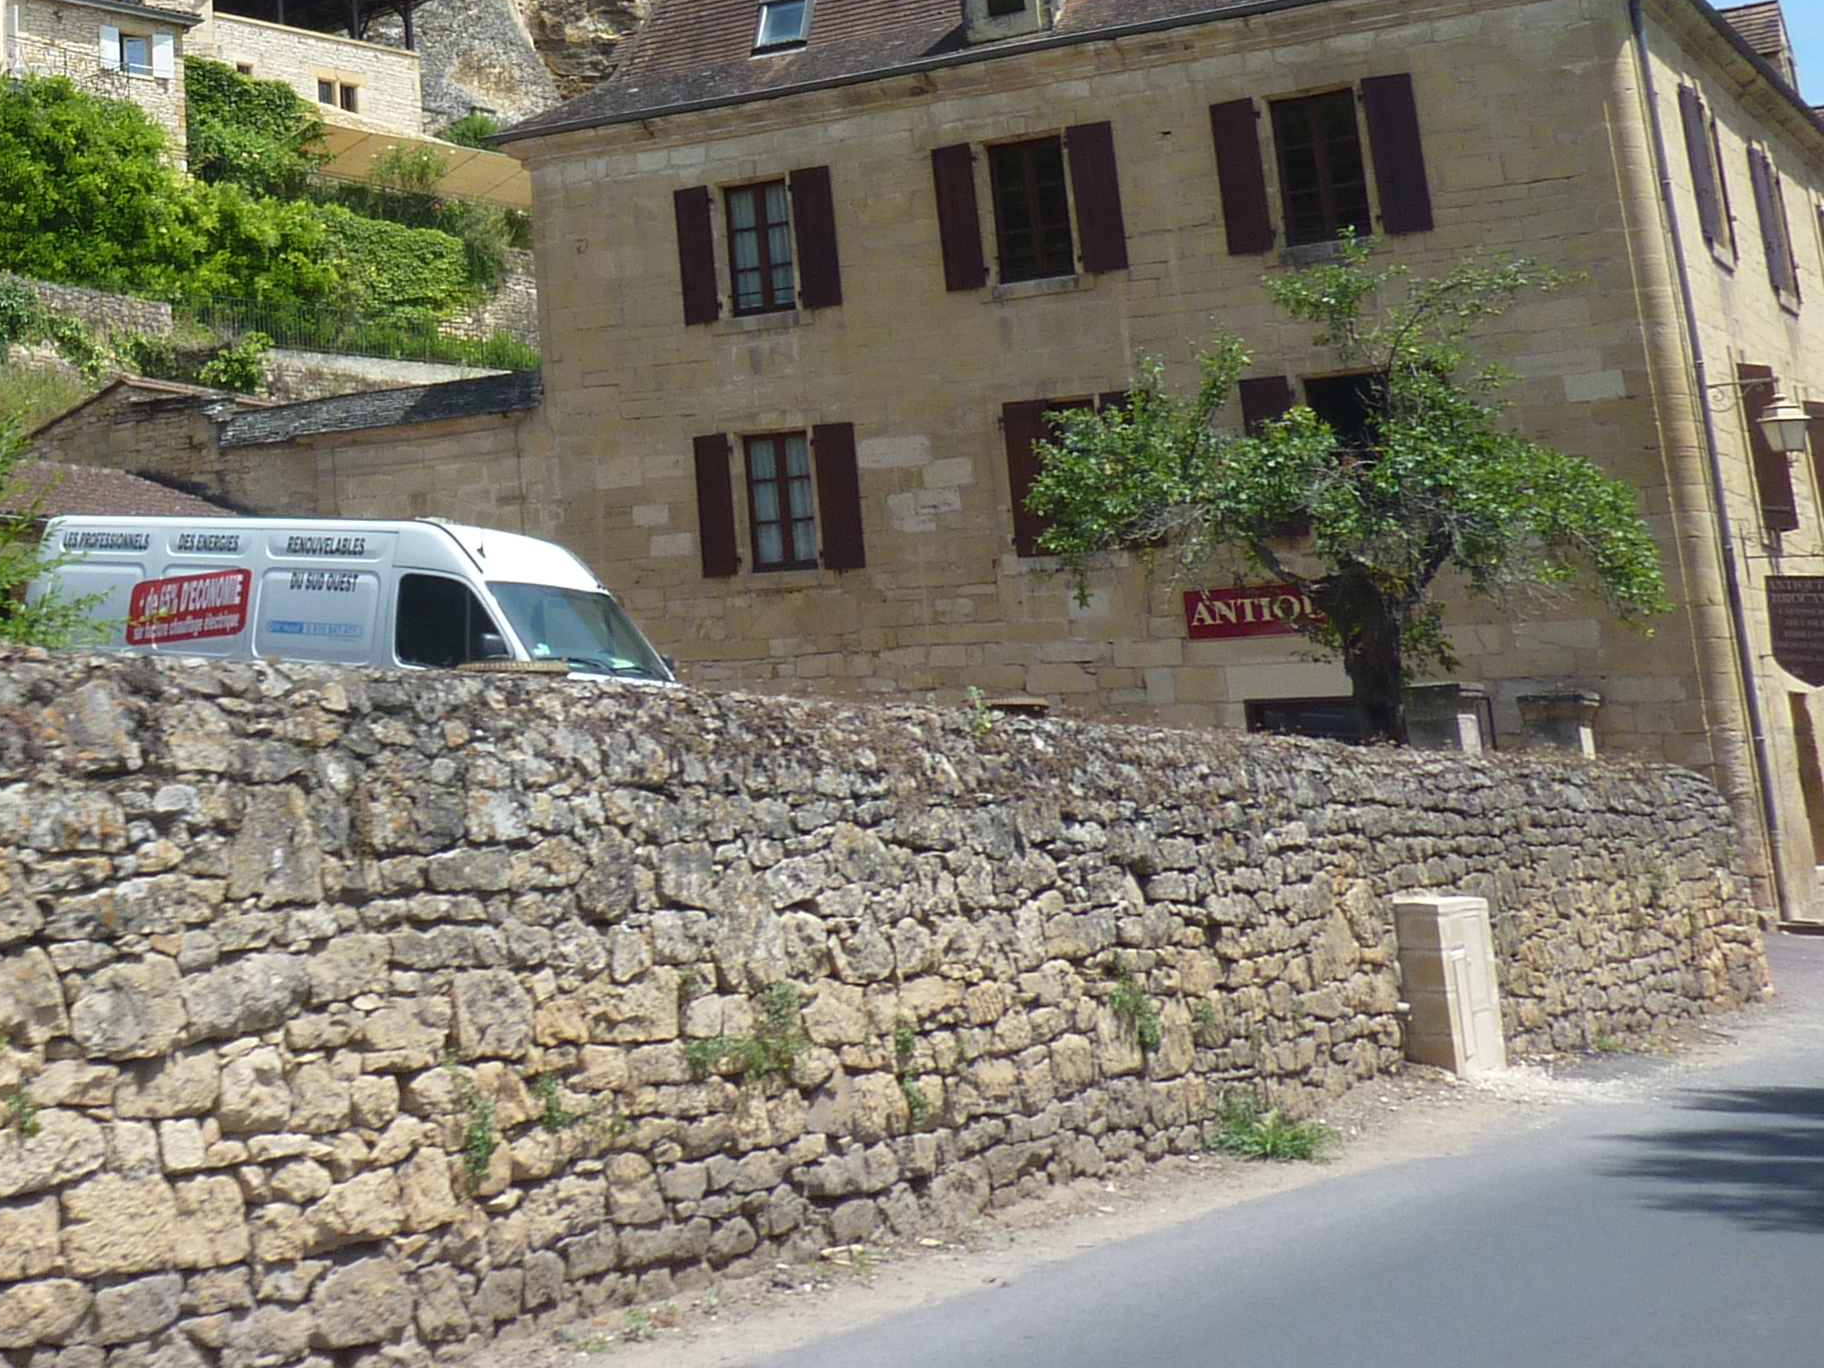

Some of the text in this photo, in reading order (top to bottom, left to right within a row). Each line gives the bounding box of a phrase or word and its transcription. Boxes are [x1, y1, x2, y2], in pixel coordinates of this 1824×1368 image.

[63, 532, 366, 556] LES PROFESSIONNELS DES ENERGIES RENOUVELABLES
[179, 574, 244, 612] D'ECONOMIE
[290, 572, 359, 592] DU SUD OUEST
[169, 616, 204, 637] chauffage
